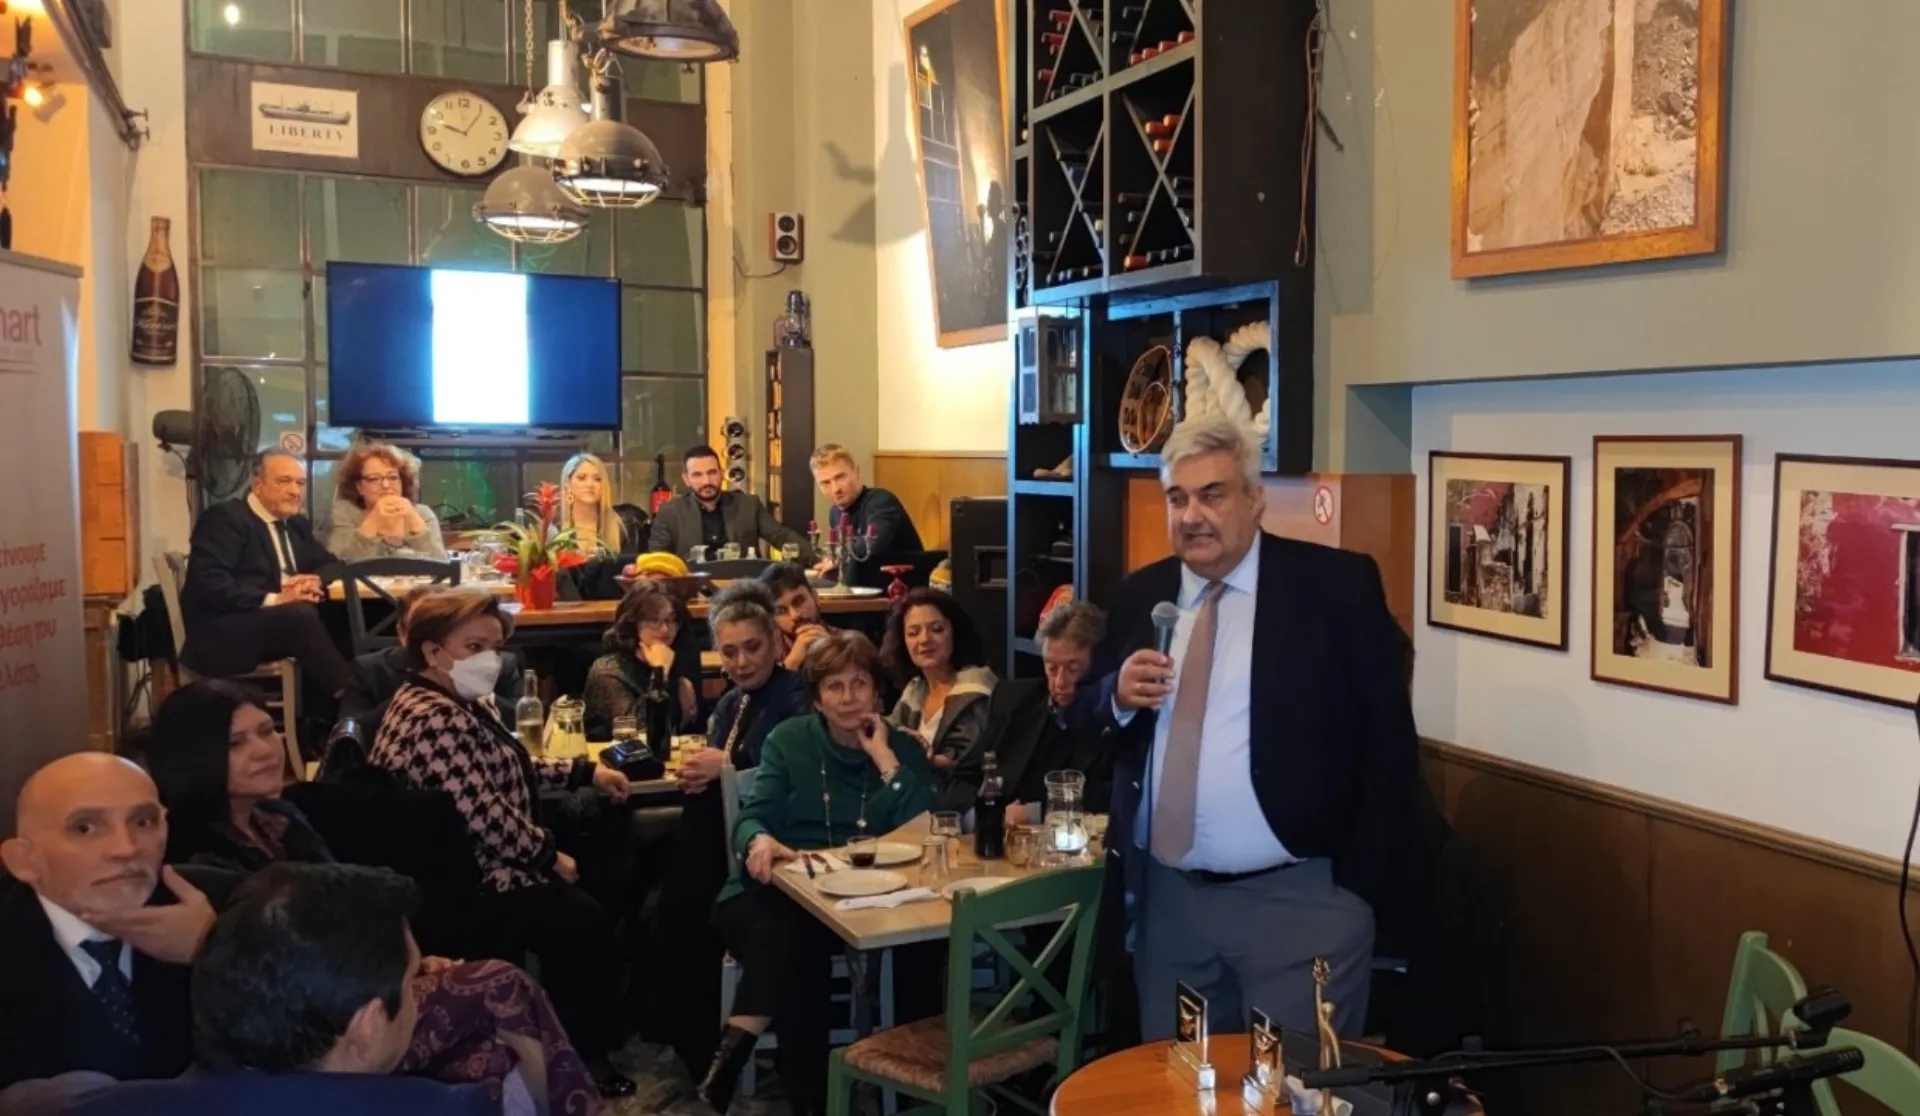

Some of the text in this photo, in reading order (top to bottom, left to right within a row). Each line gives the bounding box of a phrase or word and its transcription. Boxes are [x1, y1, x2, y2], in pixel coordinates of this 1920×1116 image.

[445, 100, 453, 111] 11
[458, 97, 470, 109] 12
[488, 116, 498, 126] 2
[269, 123, 345, 142] LIBERTY
[427, 126, 437, 136] 9
[488, 147, 497, 156] 4
